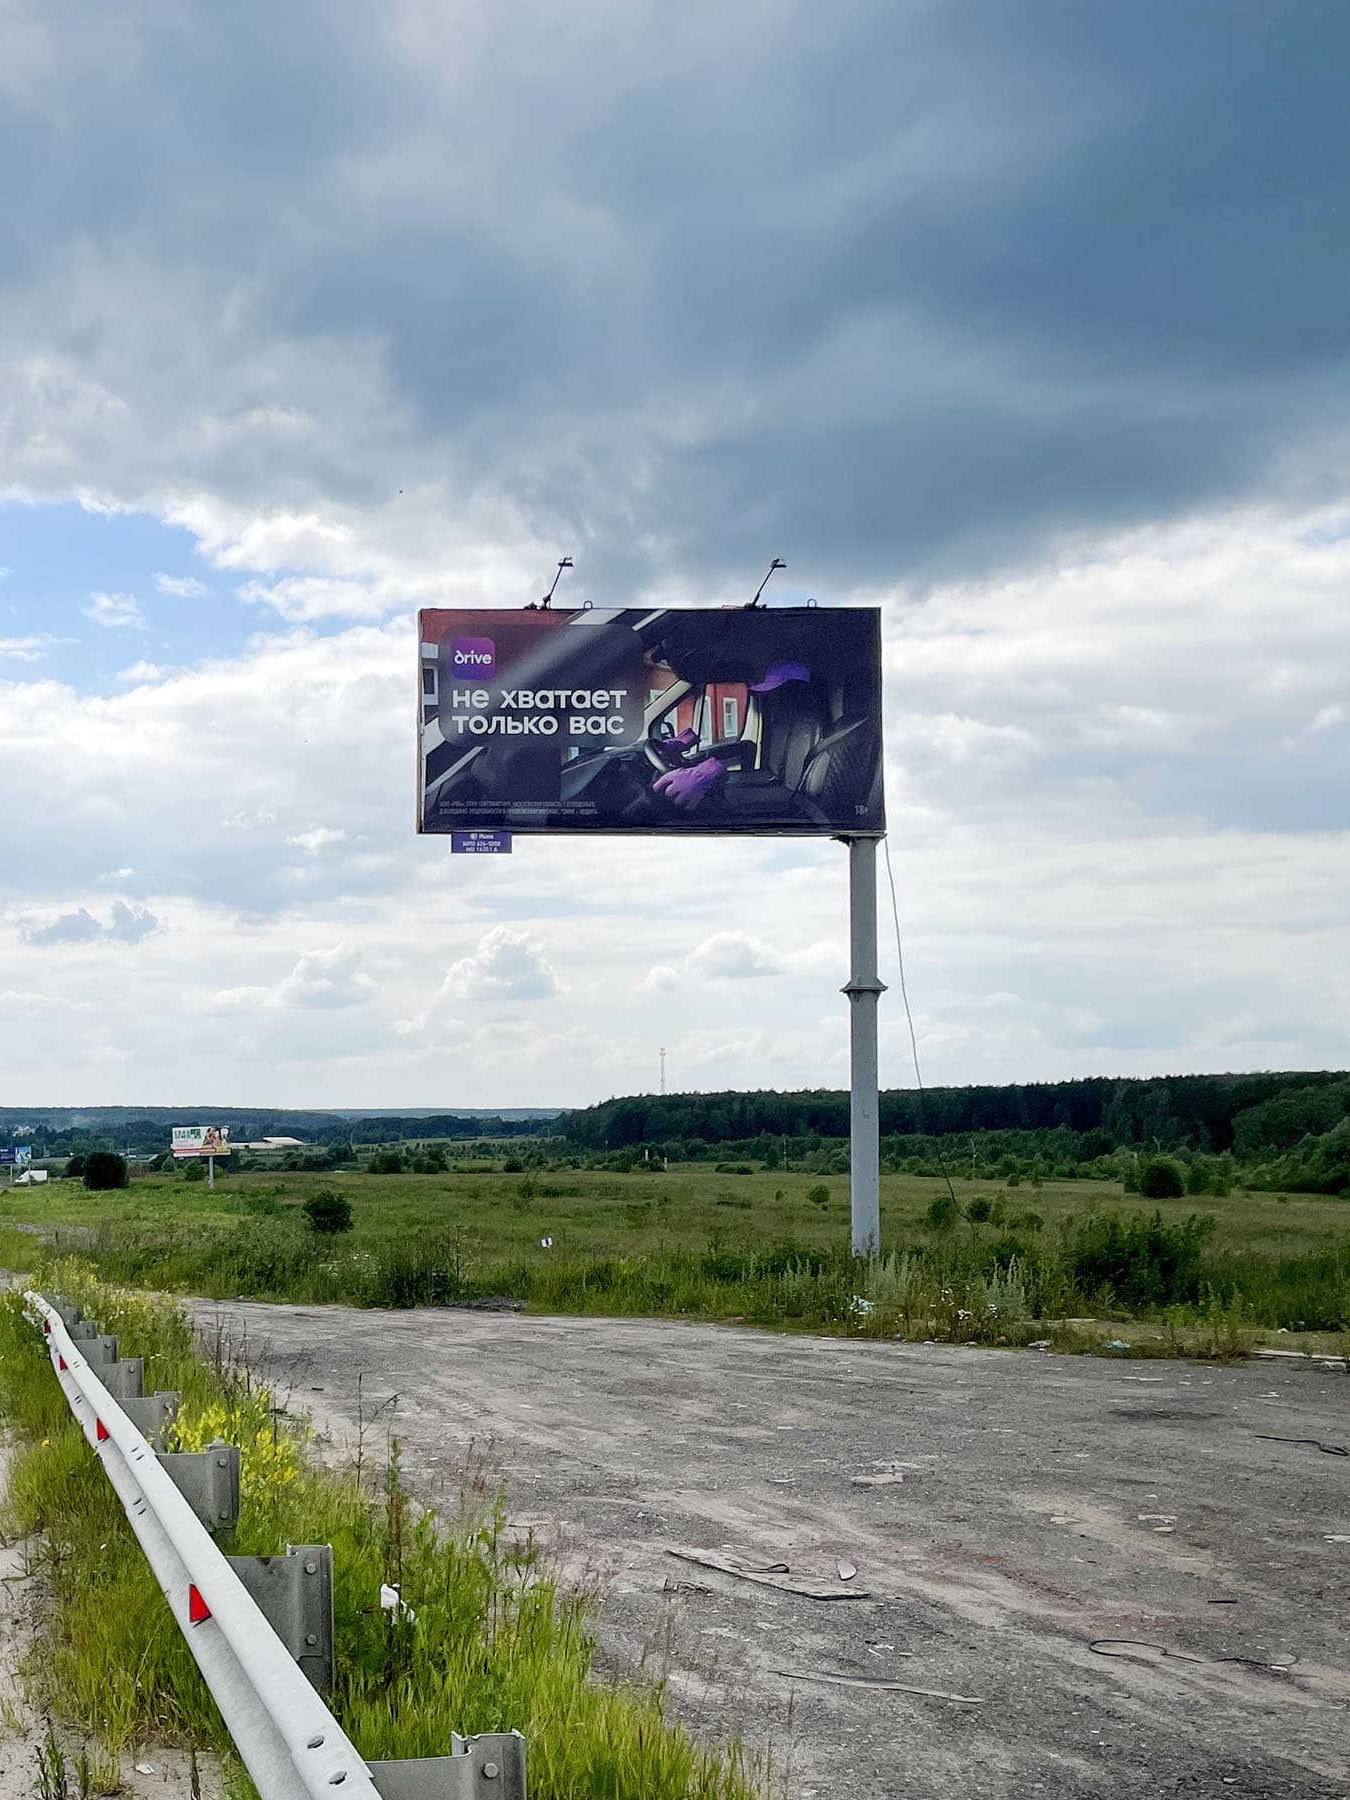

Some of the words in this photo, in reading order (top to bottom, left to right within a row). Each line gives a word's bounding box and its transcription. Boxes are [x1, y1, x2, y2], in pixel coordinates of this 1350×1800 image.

[454, 650, 492, 665] drive
[452, 689, 490, 709] не
[500, 689, 627, 709] хватает
[452, 715, 559, 735] только
[569, 715, 625, 735] вас
